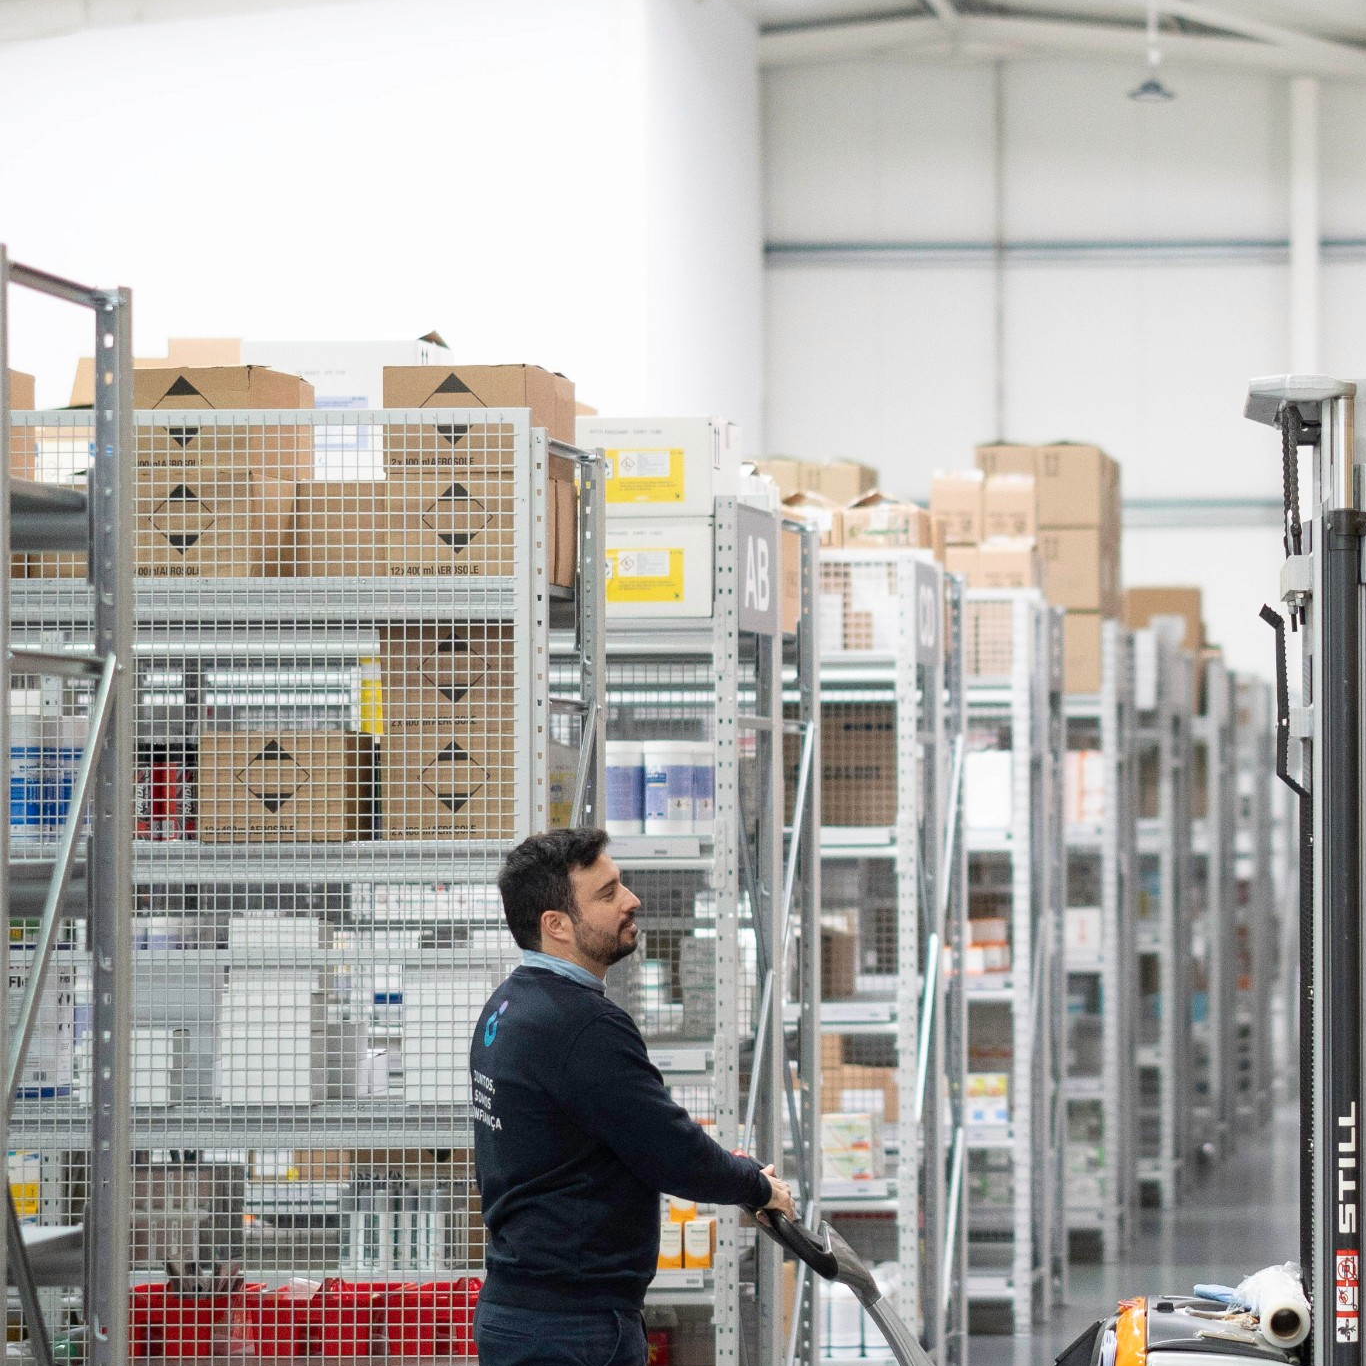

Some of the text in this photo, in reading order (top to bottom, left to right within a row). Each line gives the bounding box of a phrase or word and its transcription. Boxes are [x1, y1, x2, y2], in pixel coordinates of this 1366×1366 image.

[423, 566, 434, 575] ml
[745, 535, 770, 612] AB
[250, 825, 295, 835] AEOSOLE
[474, 1088, 492, 1110] SOMOS
[1338, 1101, 1356, 1233] STILL
